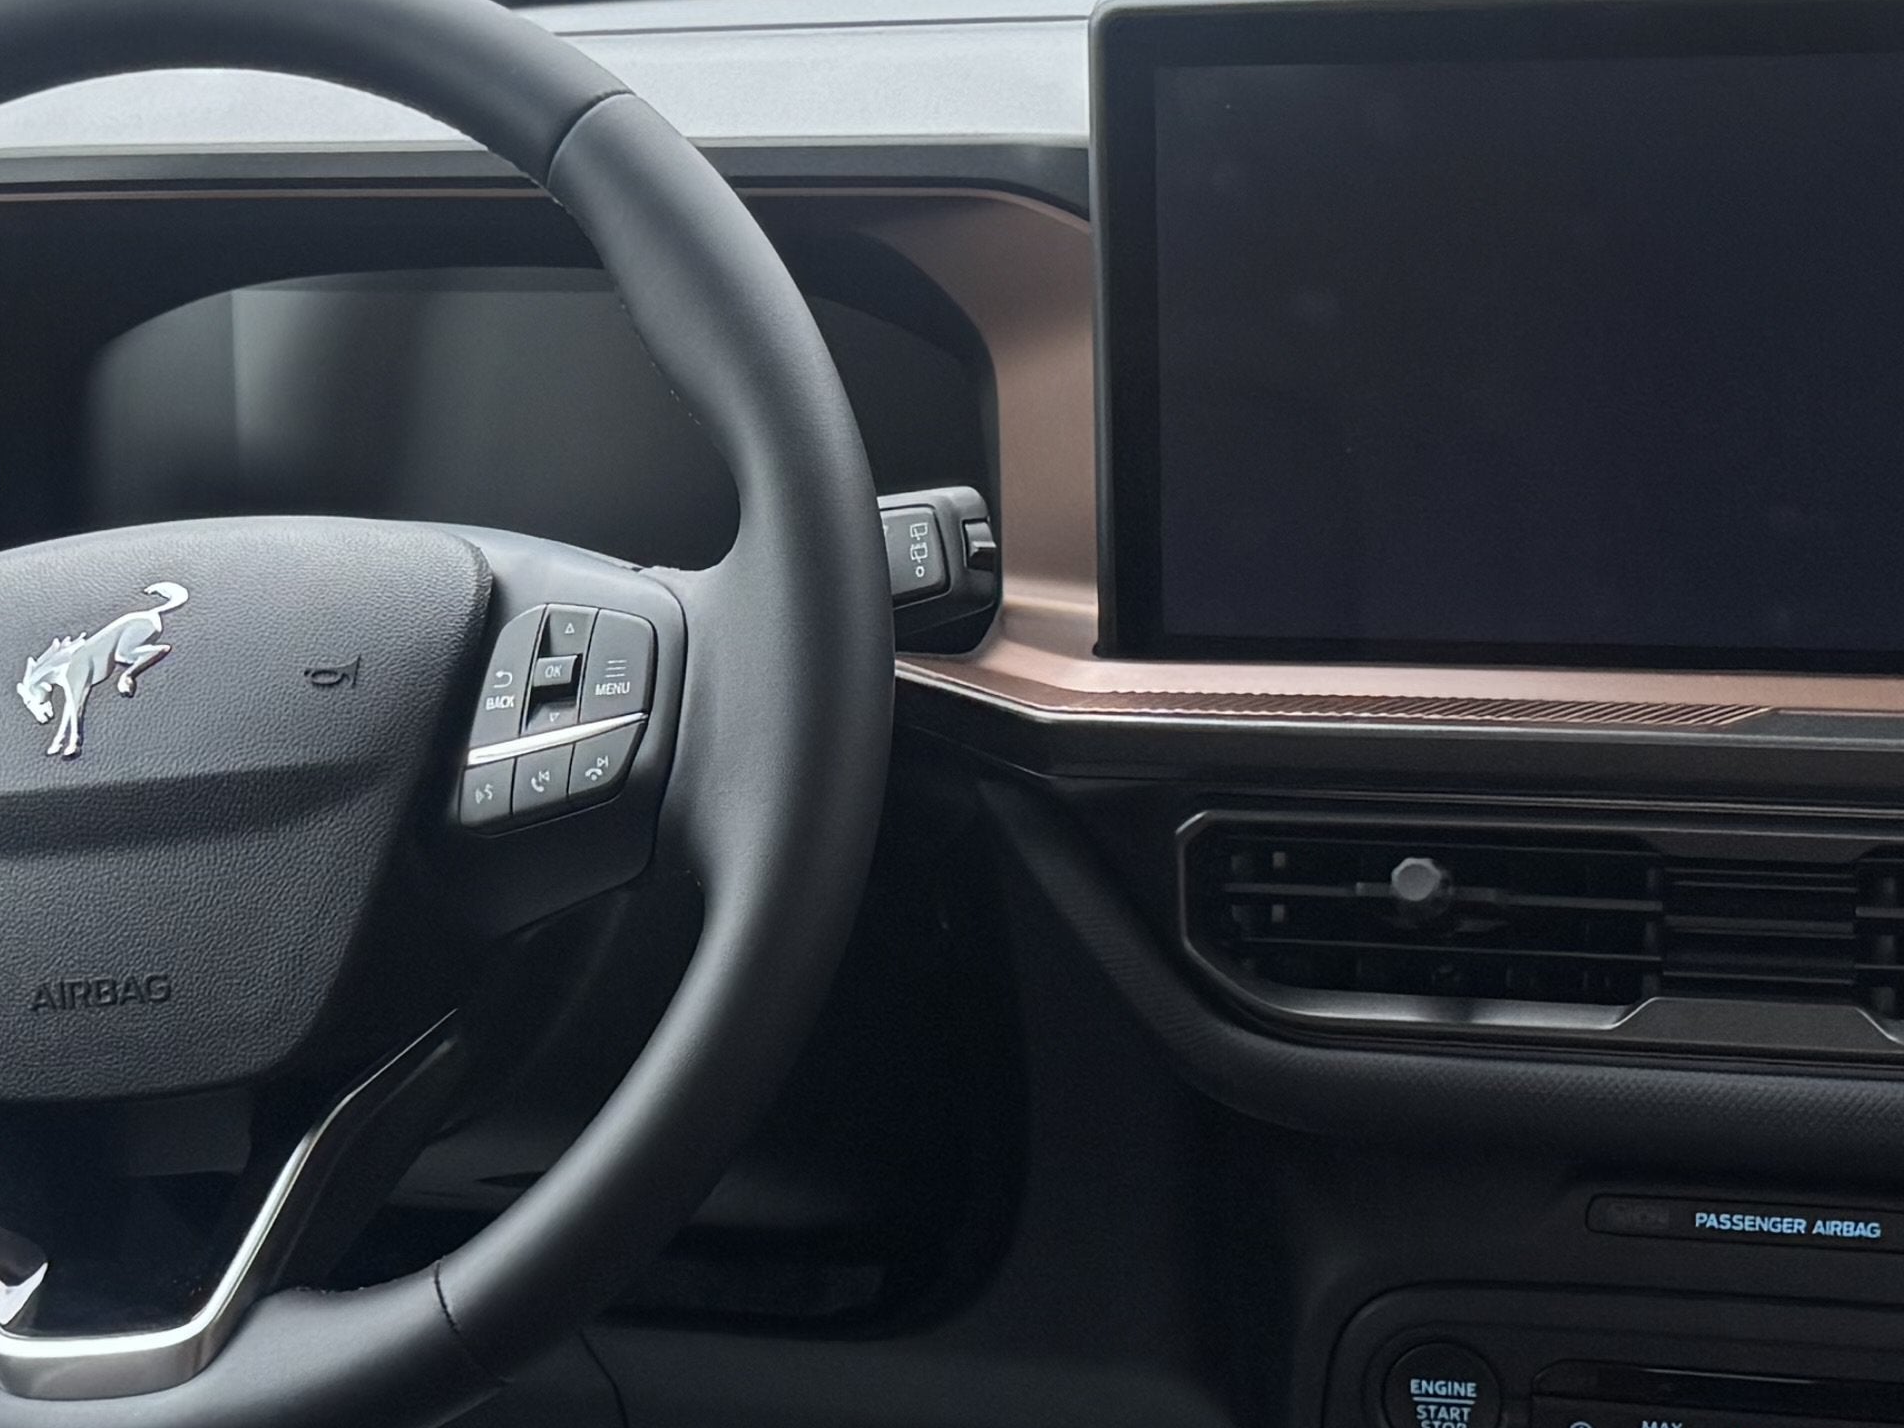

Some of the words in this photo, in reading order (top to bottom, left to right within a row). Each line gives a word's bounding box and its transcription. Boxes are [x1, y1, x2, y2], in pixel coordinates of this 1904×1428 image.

[545, 665, 562, 678] OK
[595, 681, 631, 696] MENU
[485, 695, 515, 710] BACK
[29, 973, 172, 1011] AIRBAG
[1695, 1211, 1807, 1235] PASSENGER
[1812, 1219, 1882, 1239] AIRBAG
[1410, 1378, 1478, 1398] ENGINE
[1416, 1404, 1472, 1423] START
